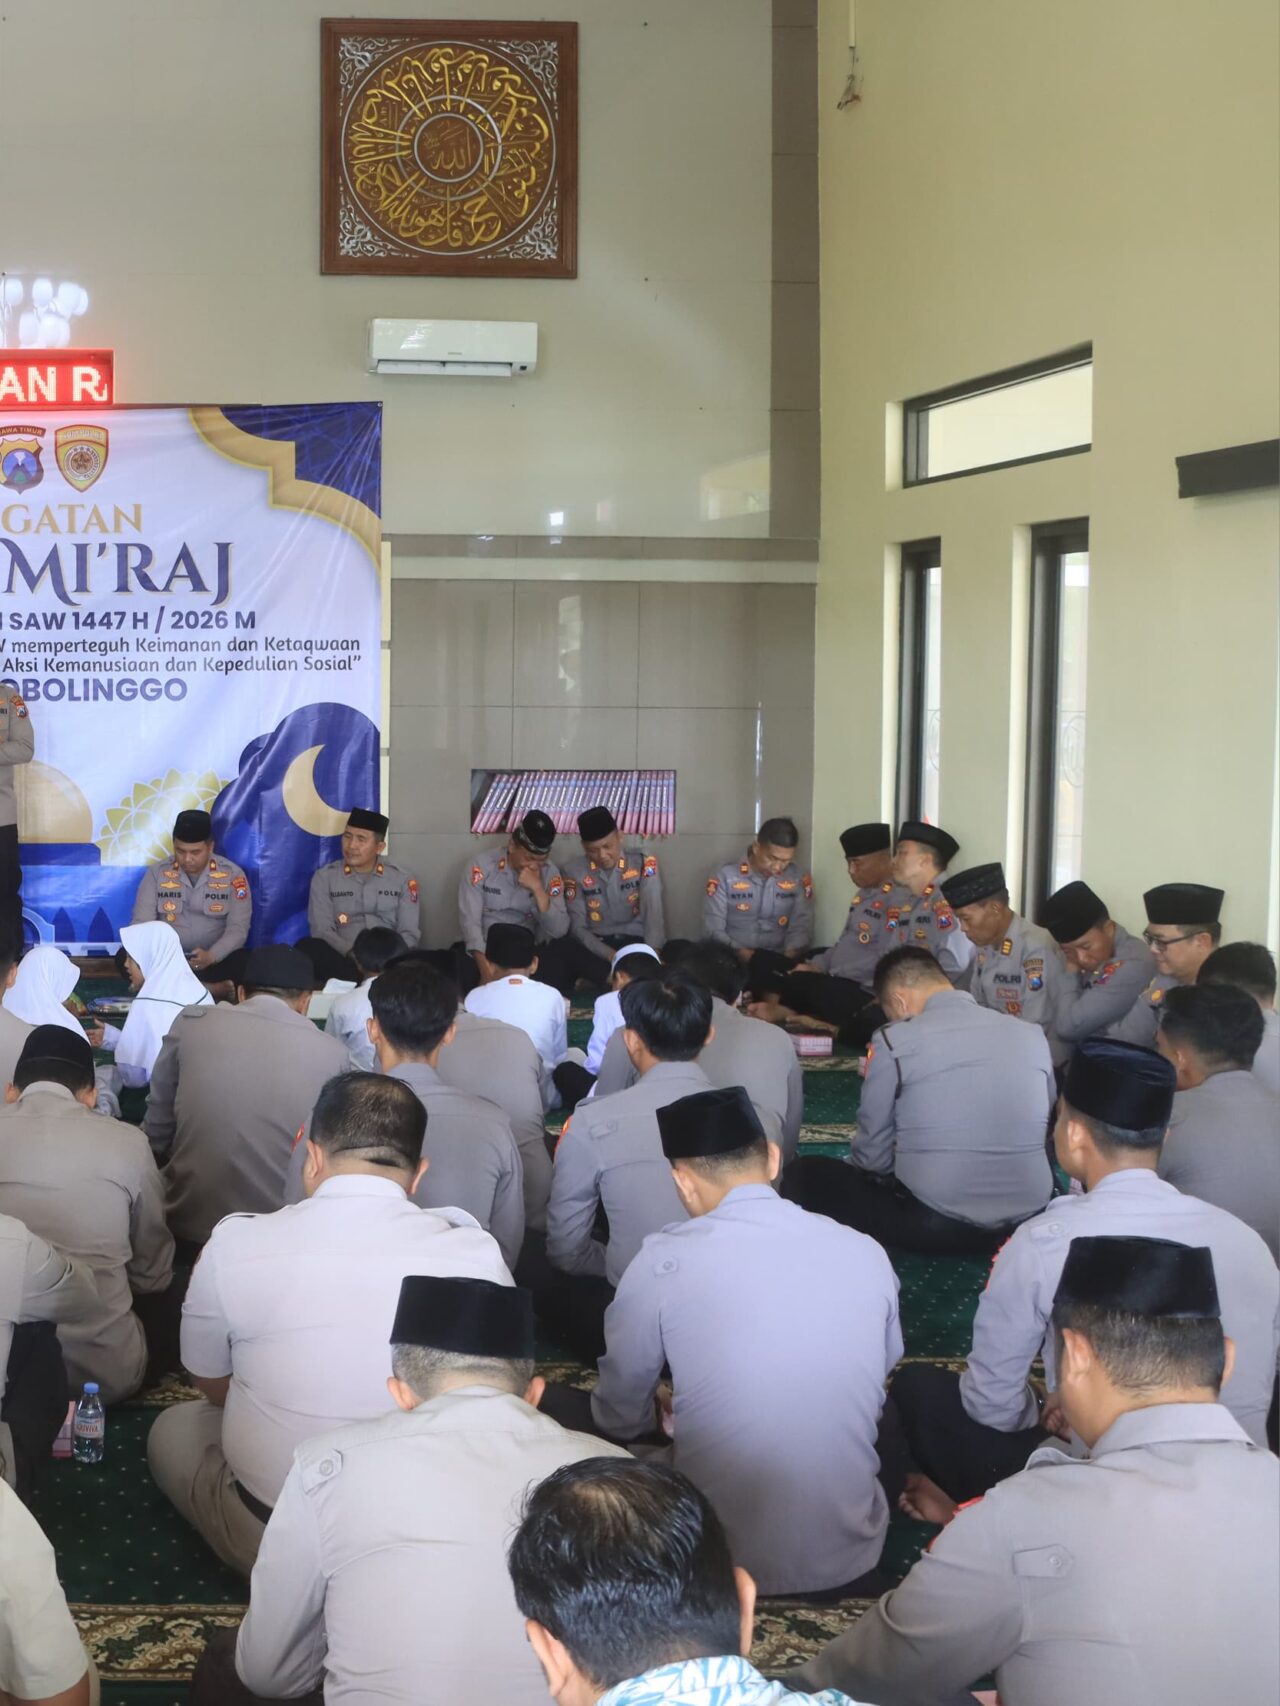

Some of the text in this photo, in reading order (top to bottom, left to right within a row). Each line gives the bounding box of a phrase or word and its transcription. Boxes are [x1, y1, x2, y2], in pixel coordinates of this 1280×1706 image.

[72, 366, 109, 402] R
[20, 427, 43, 436] TIMUR
[9, 613, 66, 631] SAW
[73, 611, 126, 631] 1447
[132, 611, 148, 630] H
[154, 605, 166, 634] /
[170, 610, 229, 630] 2026
[235, 611, 256, 629] M
[11, 638, 130, 657] memperteguh
[136, 637, 221, 652] Keimanan
[227, 636, 258, 652] dan
[264, 637, 360, 655] Ketaqwaan
[2, 657, 39, 673] Aksi
[44, 656, 160, 673] Kemanusiaan
[165, 656, 198, 672] dan
[203, 655, 299, 675] Kepedulian
[0, 678, 188, 702] OBOLINGGO
[158, 891, 182, 899] HARIS
[993, 973, 1022, 985] POLRI
